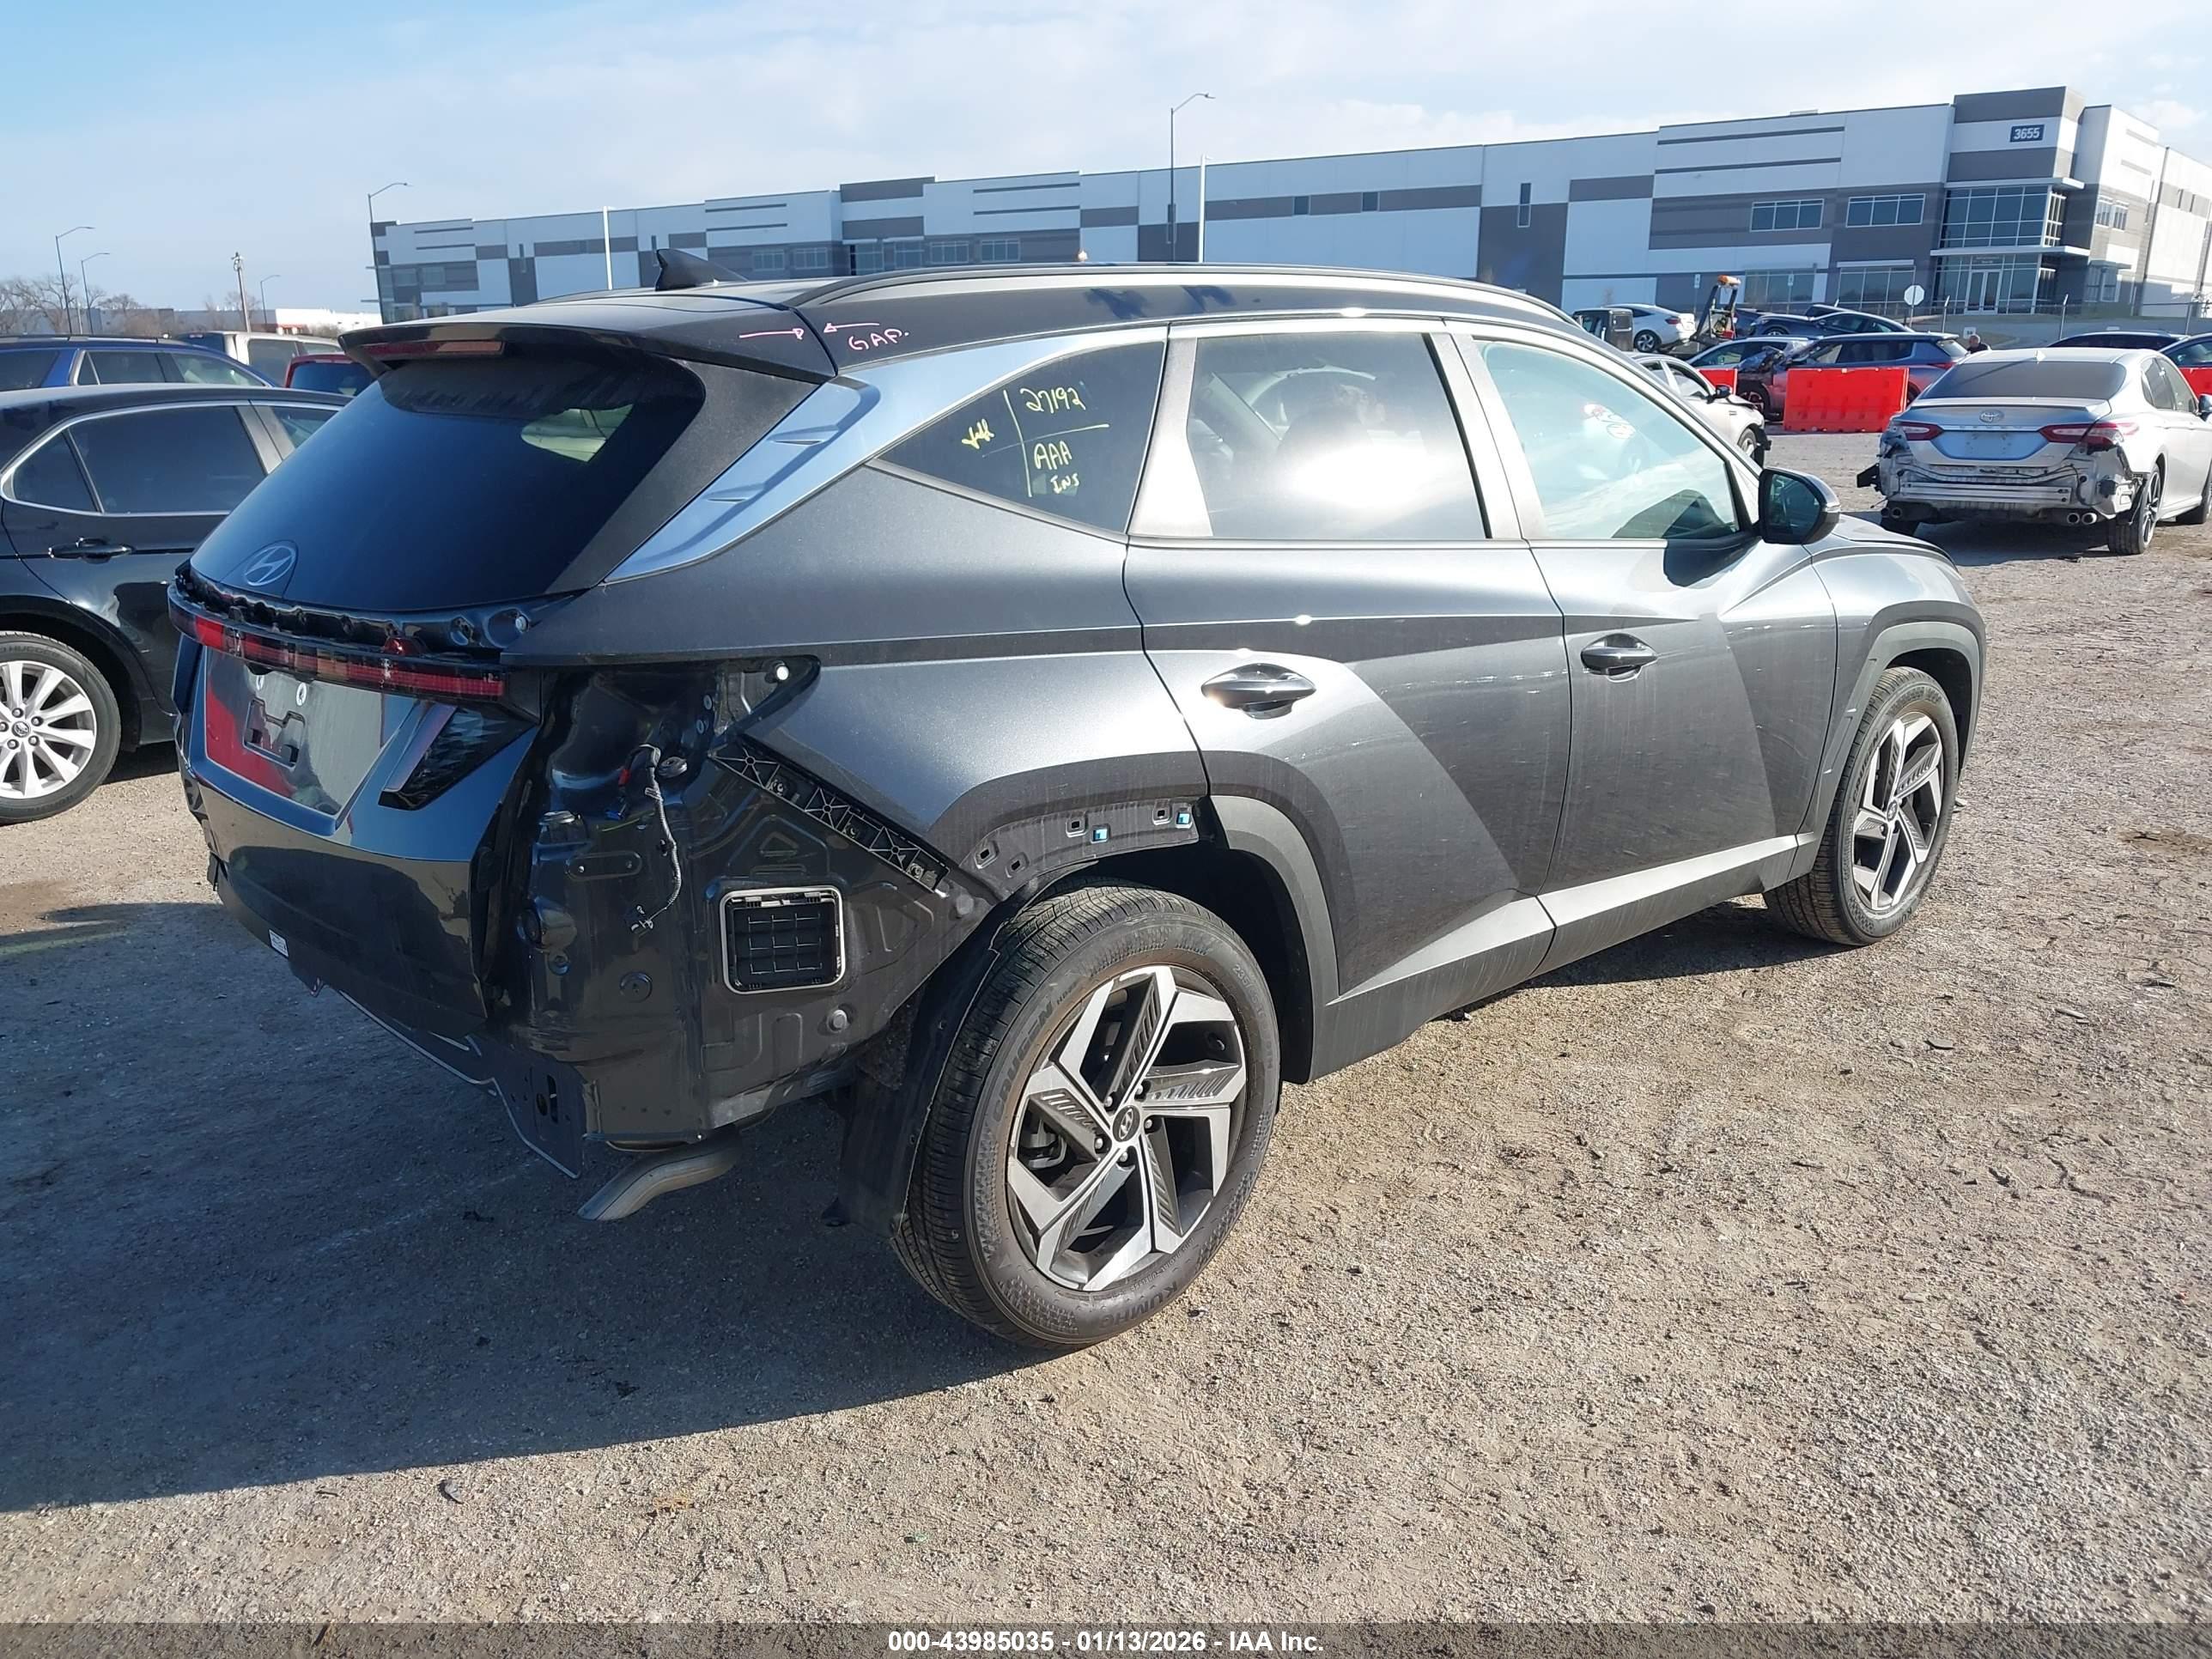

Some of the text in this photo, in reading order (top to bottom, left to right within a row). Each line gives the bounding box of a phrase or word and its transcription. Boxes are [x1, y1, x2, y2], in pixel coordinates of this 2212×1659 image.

[2014, 128, 2041, 139] 3655
[1020, 387, 1086, 414] 27192
[1033, 440, 1073, 470] AAA
[991, 999, 1053, 1122] CRUGEN
[1098, 1280, 1178, 1328] KUMHO
